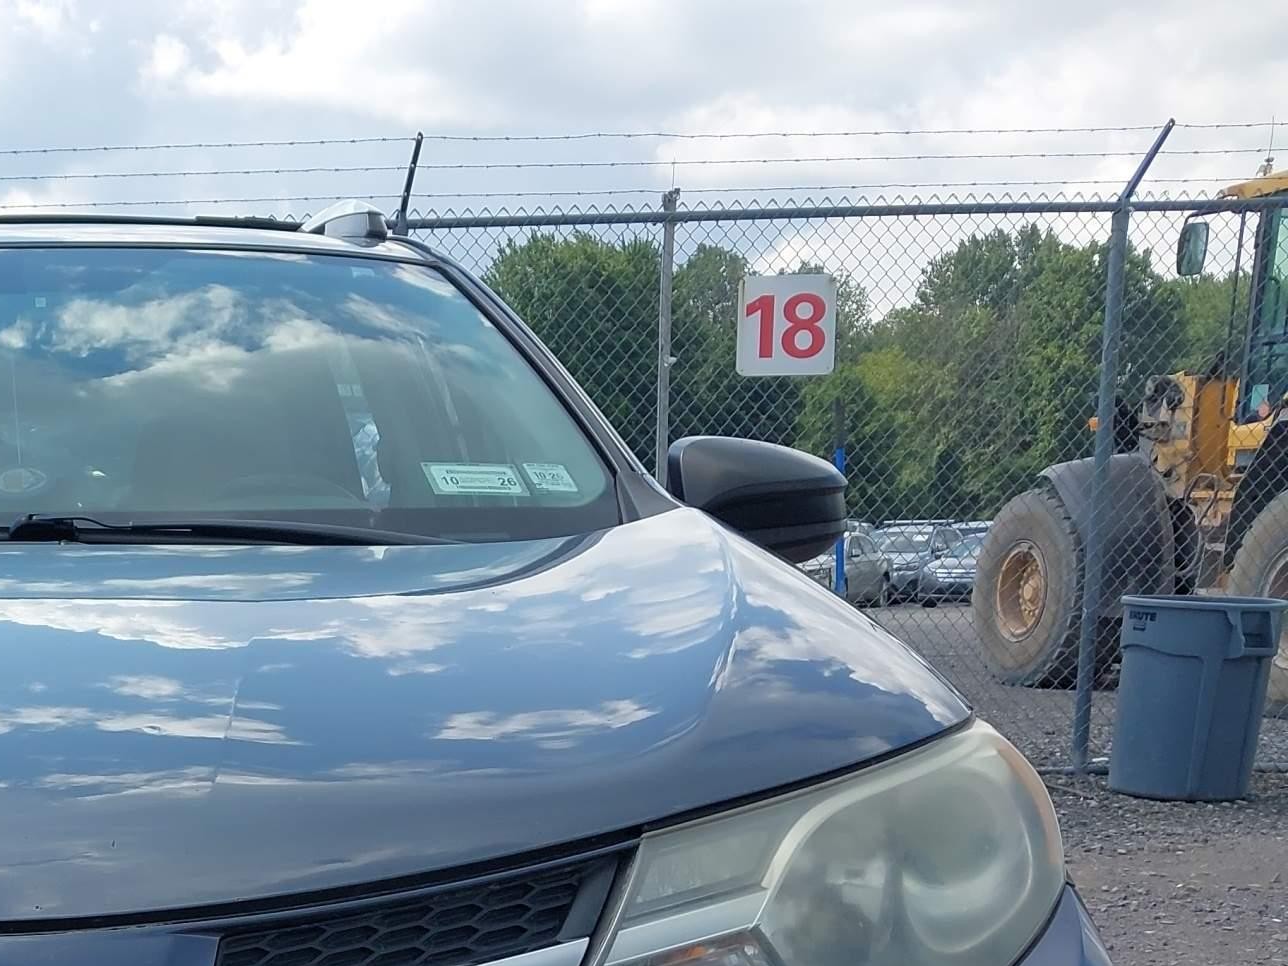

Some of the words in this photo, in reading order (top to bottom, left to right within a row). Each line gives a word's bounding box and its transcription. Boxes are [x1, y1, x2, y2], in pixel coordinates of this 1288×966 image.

[745, 292, 826, 359] 18
[440, 476, 460, 486] 10
[497, 477, 517, 487] 26
